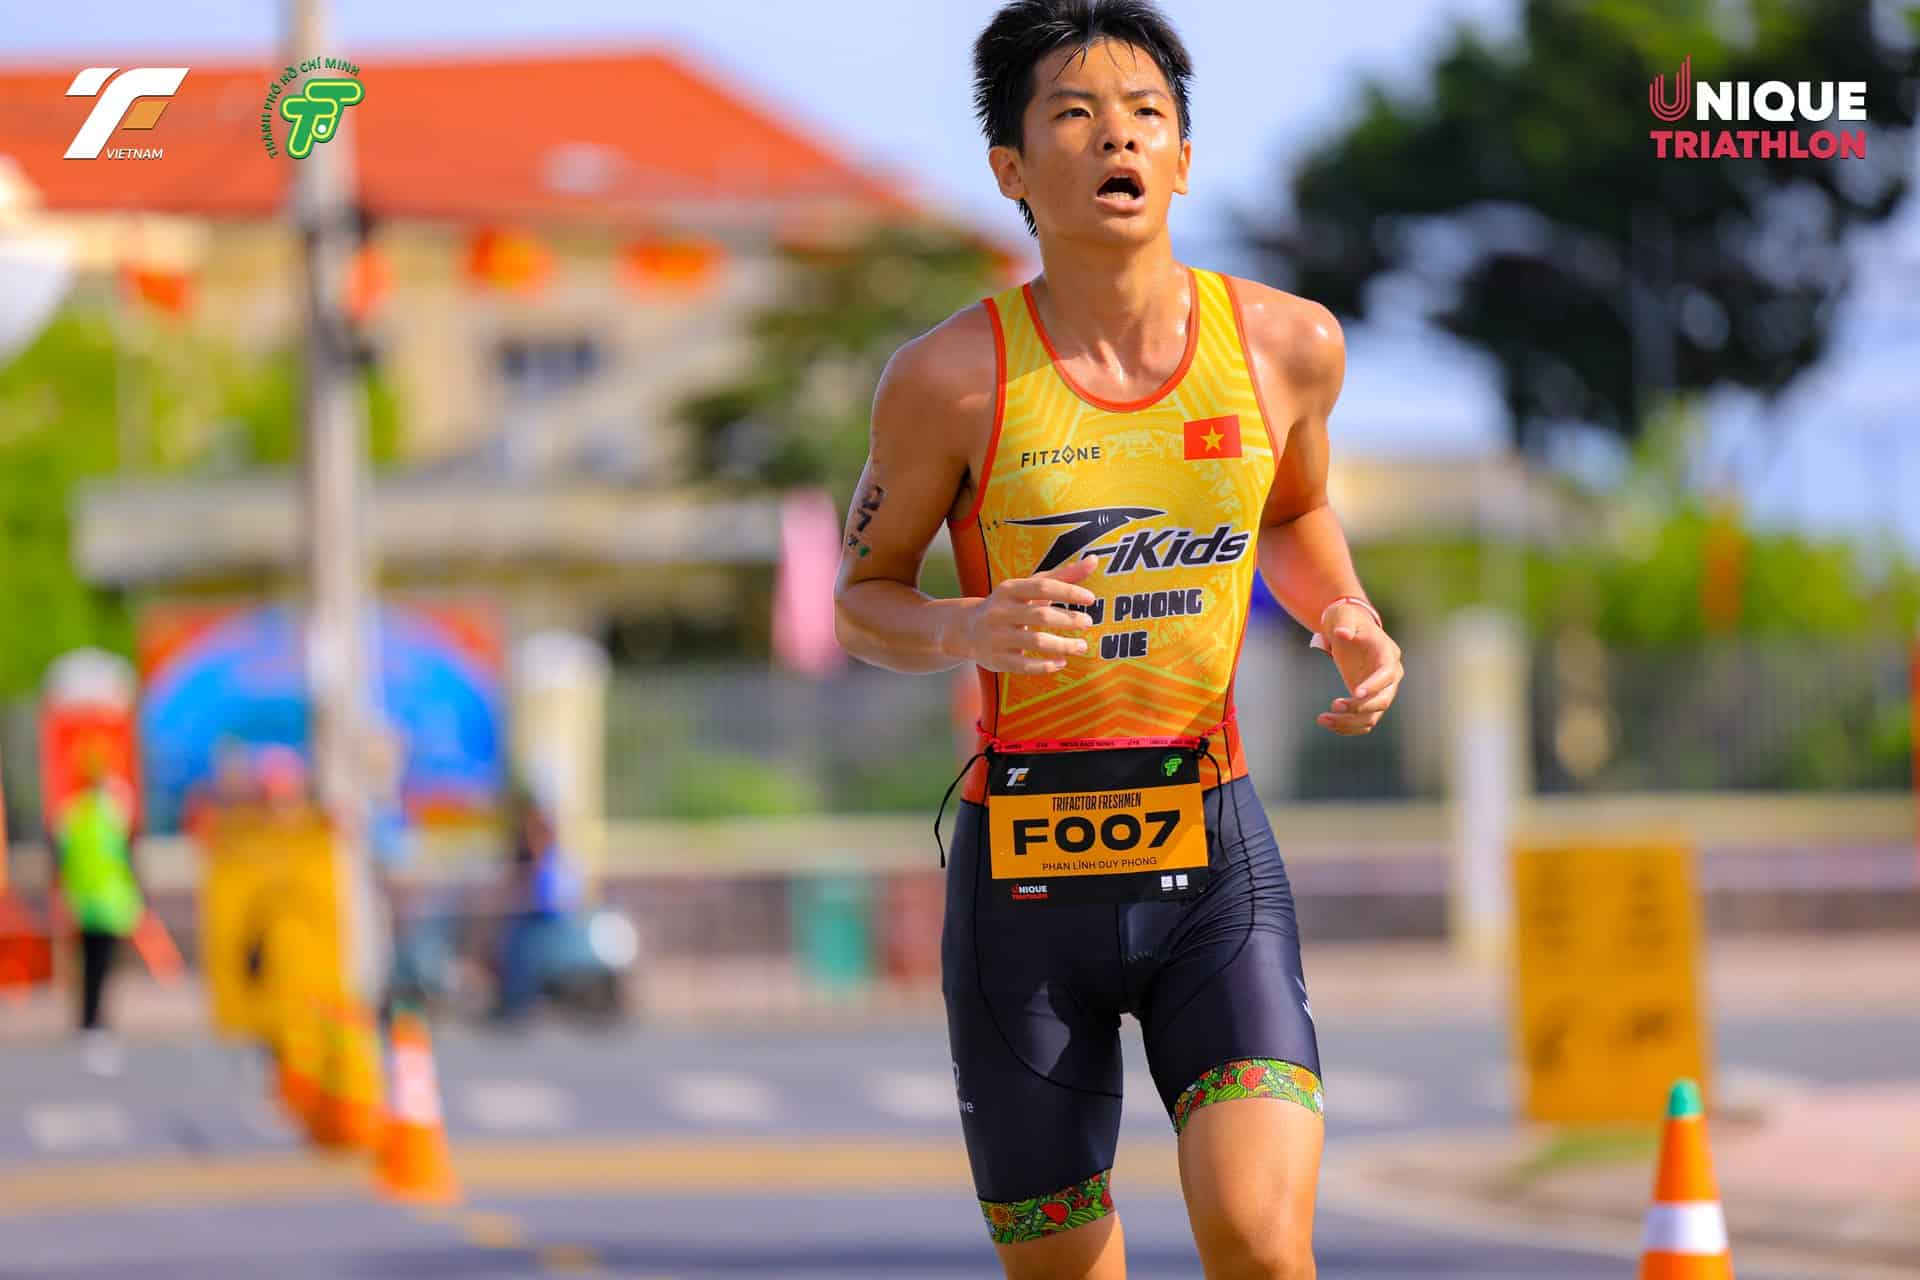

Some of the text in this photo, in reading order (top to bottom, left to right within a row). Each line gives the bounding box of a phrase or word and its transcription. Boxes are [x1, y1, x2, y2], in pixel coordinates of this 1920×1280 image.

[1021, 445, 1101, 468] FITZONE
[1114, 589, 1203, 623] PHONG
[1052, 792, 1142, 812] TRIFACTOR FRESHMEN
[1012, 809, 1181, 856] F007
[1042, 862, 1071, 871] PHAN
[1098, 859, 1119, 868] DUY
[1121, 856, 1157, 867] PHONG
